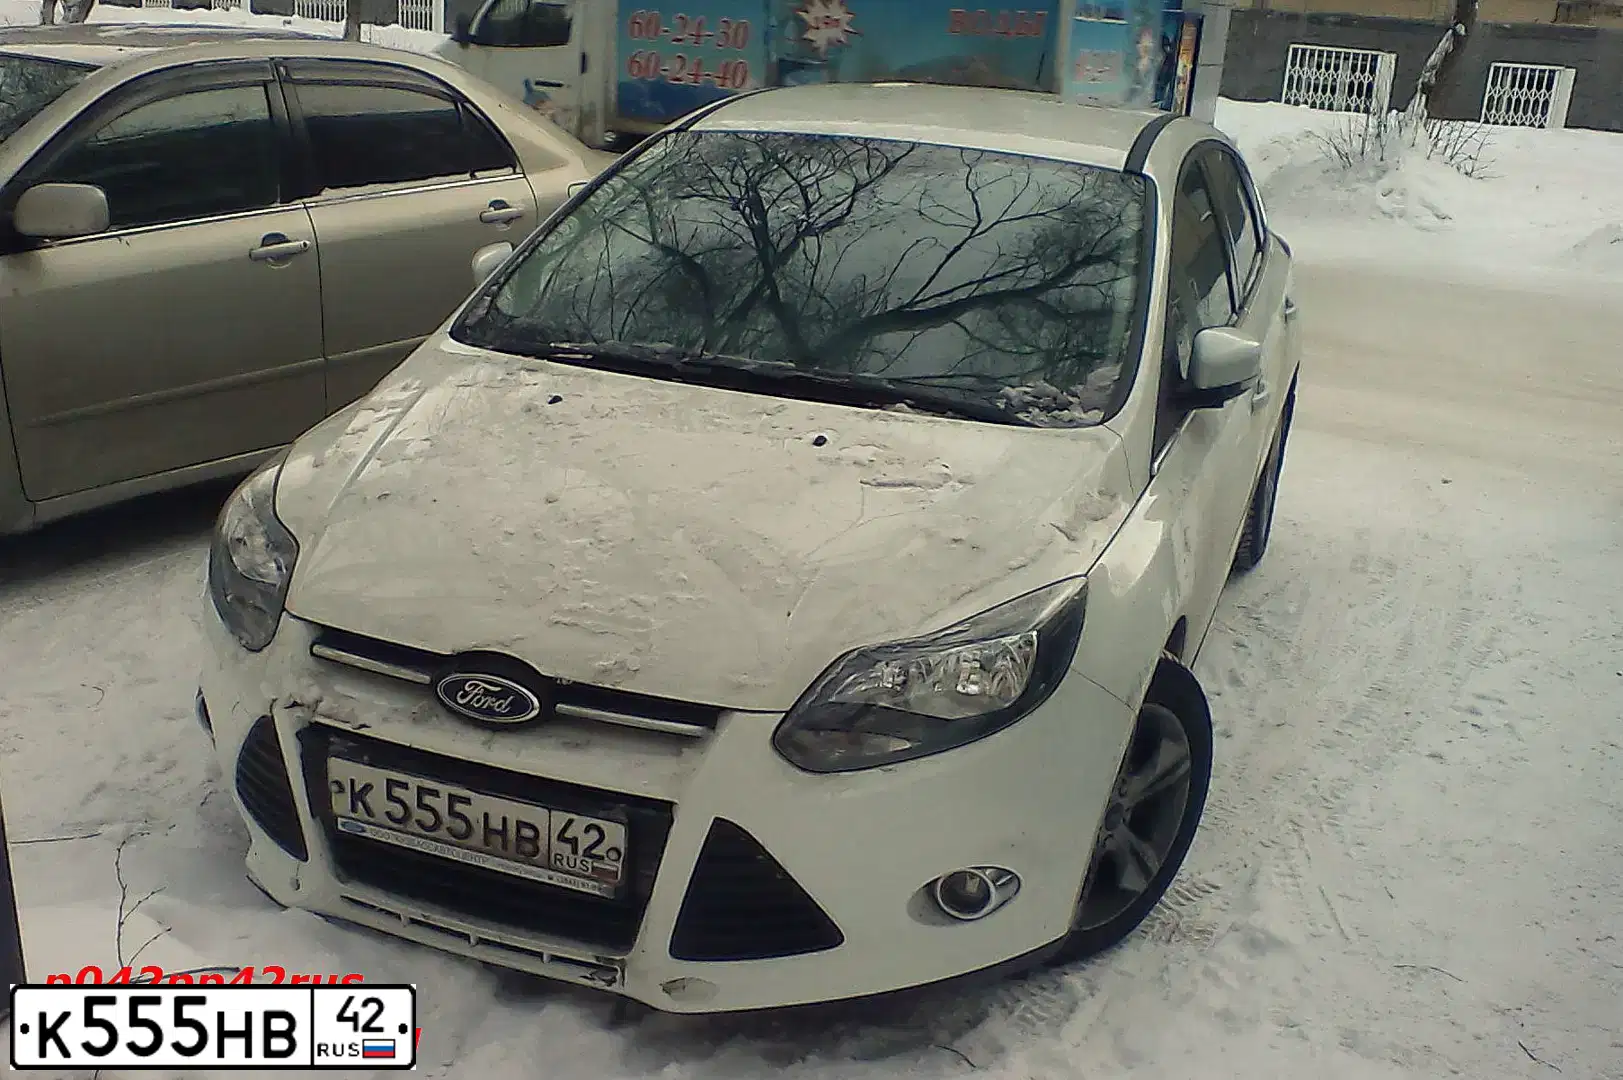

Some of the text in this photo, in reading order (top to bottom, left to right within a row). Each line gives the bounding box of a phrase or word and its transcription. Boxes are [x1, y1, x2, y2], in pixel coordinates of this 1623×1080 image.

[628, 9, 749, 50] 60-24-30
[627, 49, 749, 89] 60-24-40
[456, 680, 516, 714] Ford
[556, 818, 606, 862] 42
[553, 853, 590, 872] RUS
